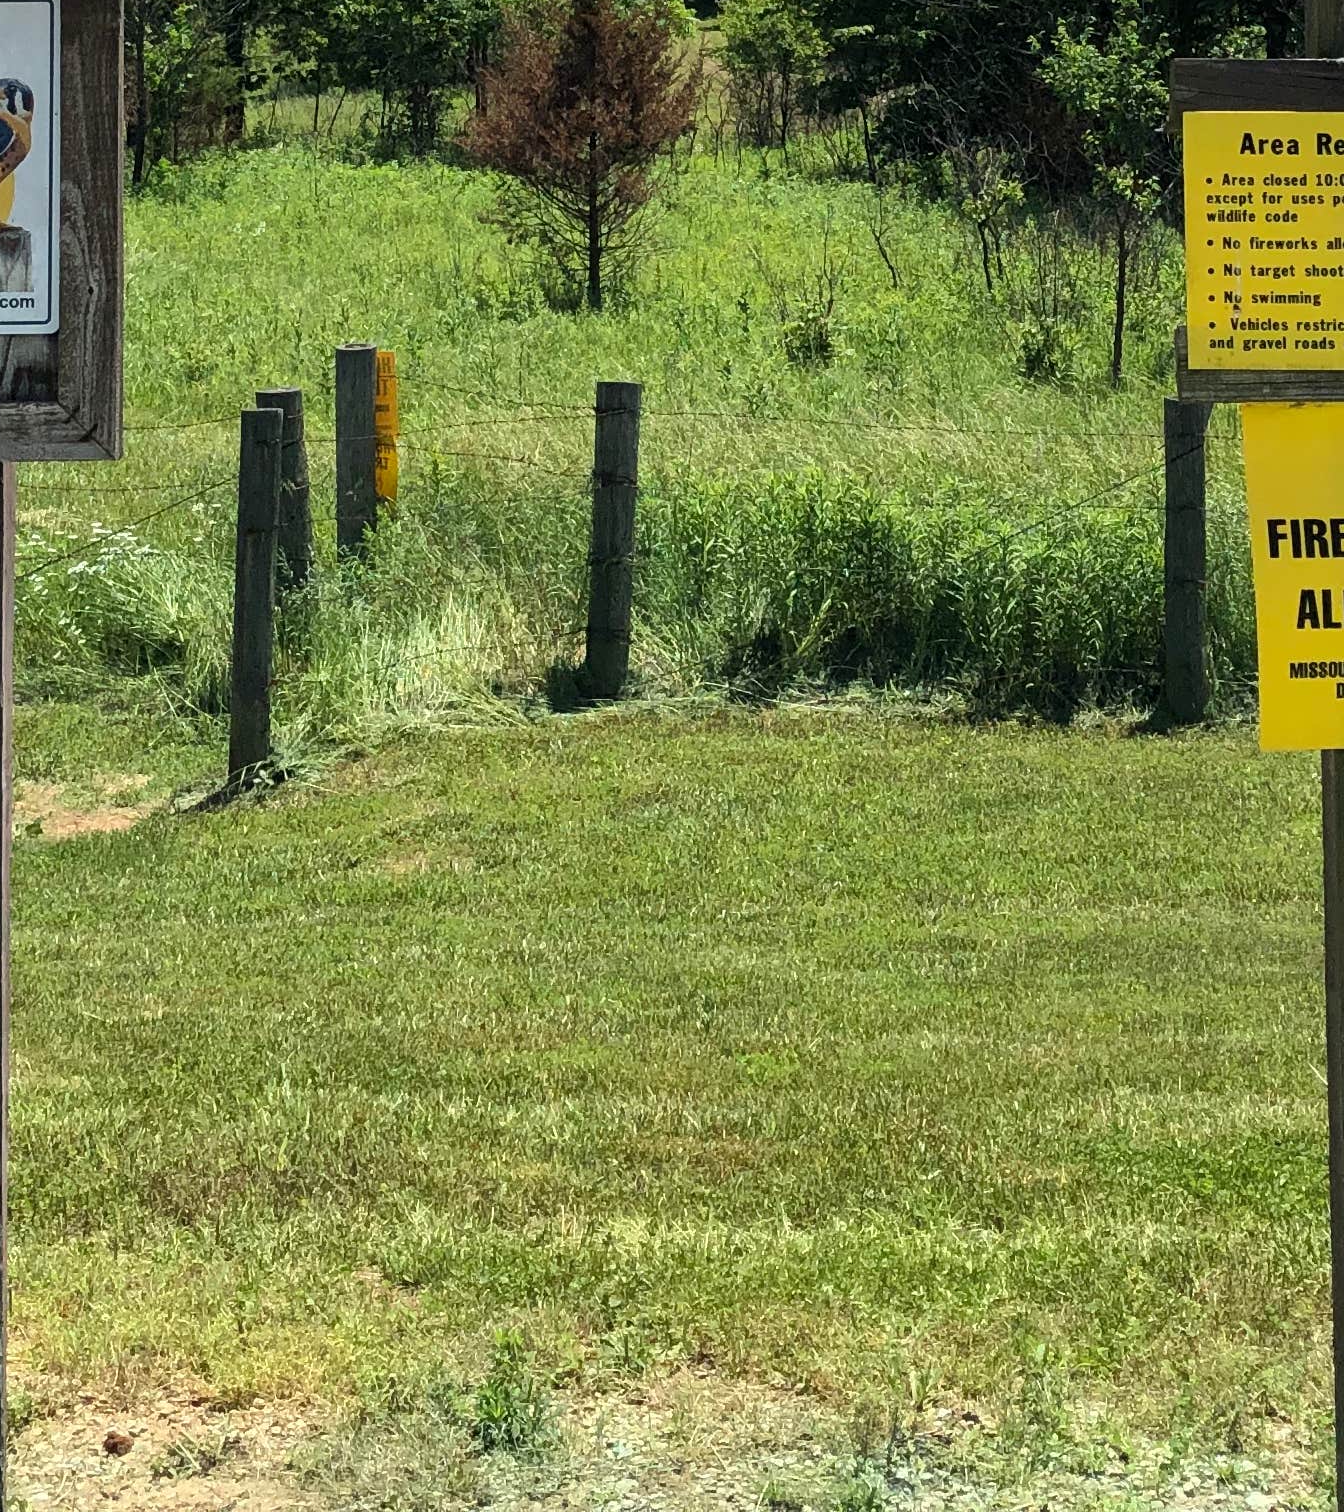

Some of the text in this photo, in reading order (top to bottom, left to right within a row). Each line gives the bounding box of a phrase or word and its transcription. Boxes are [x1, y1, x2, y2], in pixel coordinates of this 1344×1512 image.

[1240, 132, 1298, 154] Area
[1222, 173, 1254, 185] Area
[1263, 173, 1306, 186] closed
[1206, 192, 1253, 206] except
[1262, 192, 1282, 204] for
[1292, 195, 1324, 204] uses
[1206, 210, 1297, 222] wildlife code
[1222, 237, 1240, 249] No
[1249, 237, 1317, 249] fireworks
[1224, 264, 1241, 276] No
[1250, 264, 1294, 279] target
[1224, 291, 1320, 305] No swimming
[1230, 318, 1288, 330] Vehicles
[1209, 337, 1233, 348] and
[1243, 337, 1286, 351] gravel
[1295, 337, 1335, 349] roads
